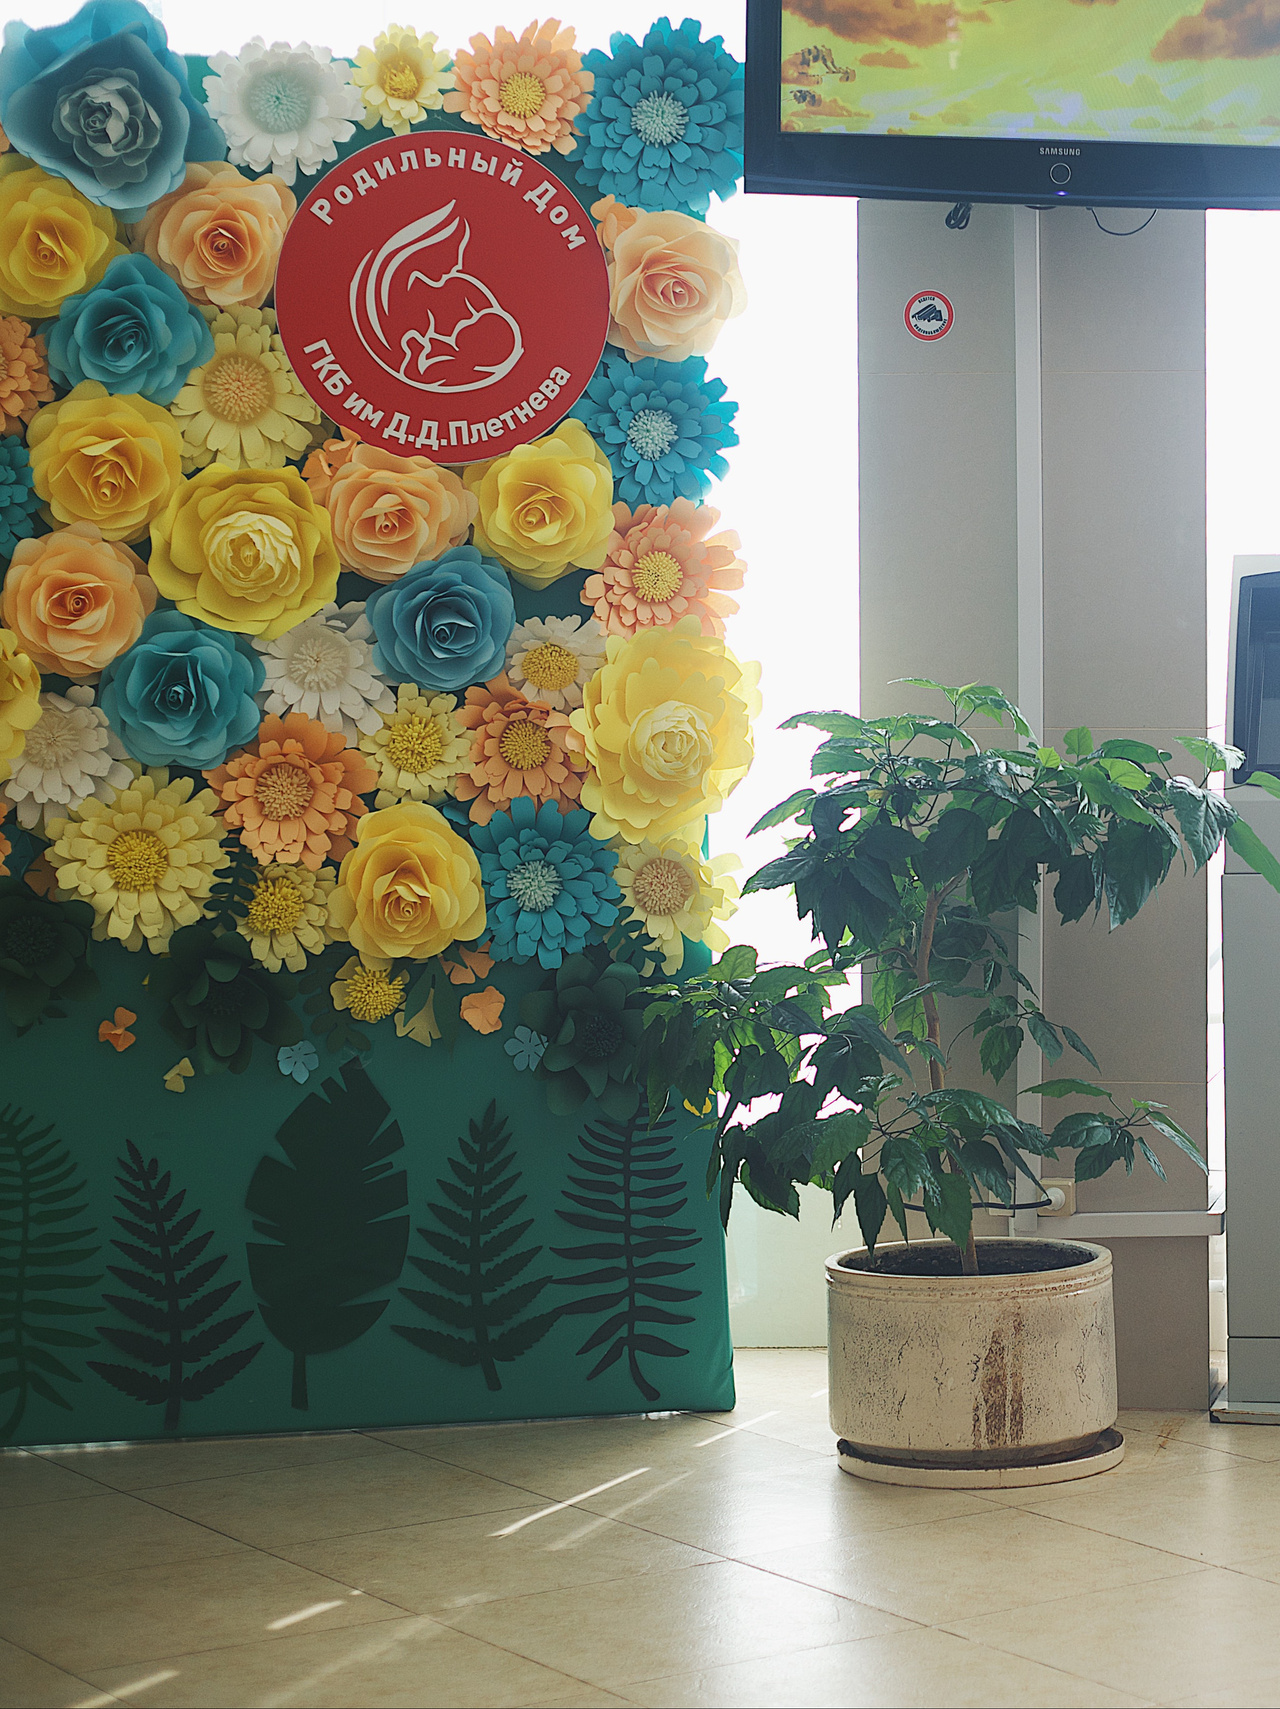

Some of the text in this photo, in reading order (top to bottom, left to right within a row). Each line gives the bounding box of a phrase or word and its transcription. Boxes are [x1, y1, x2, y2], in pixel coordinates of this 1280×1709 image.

[309, 147, 588, 251] Родильный Дом
[1039, 147, 1081, 156] SAMSUNG
[303, 338, 573, 451] ГКБ им Д.Д.Плетнева
